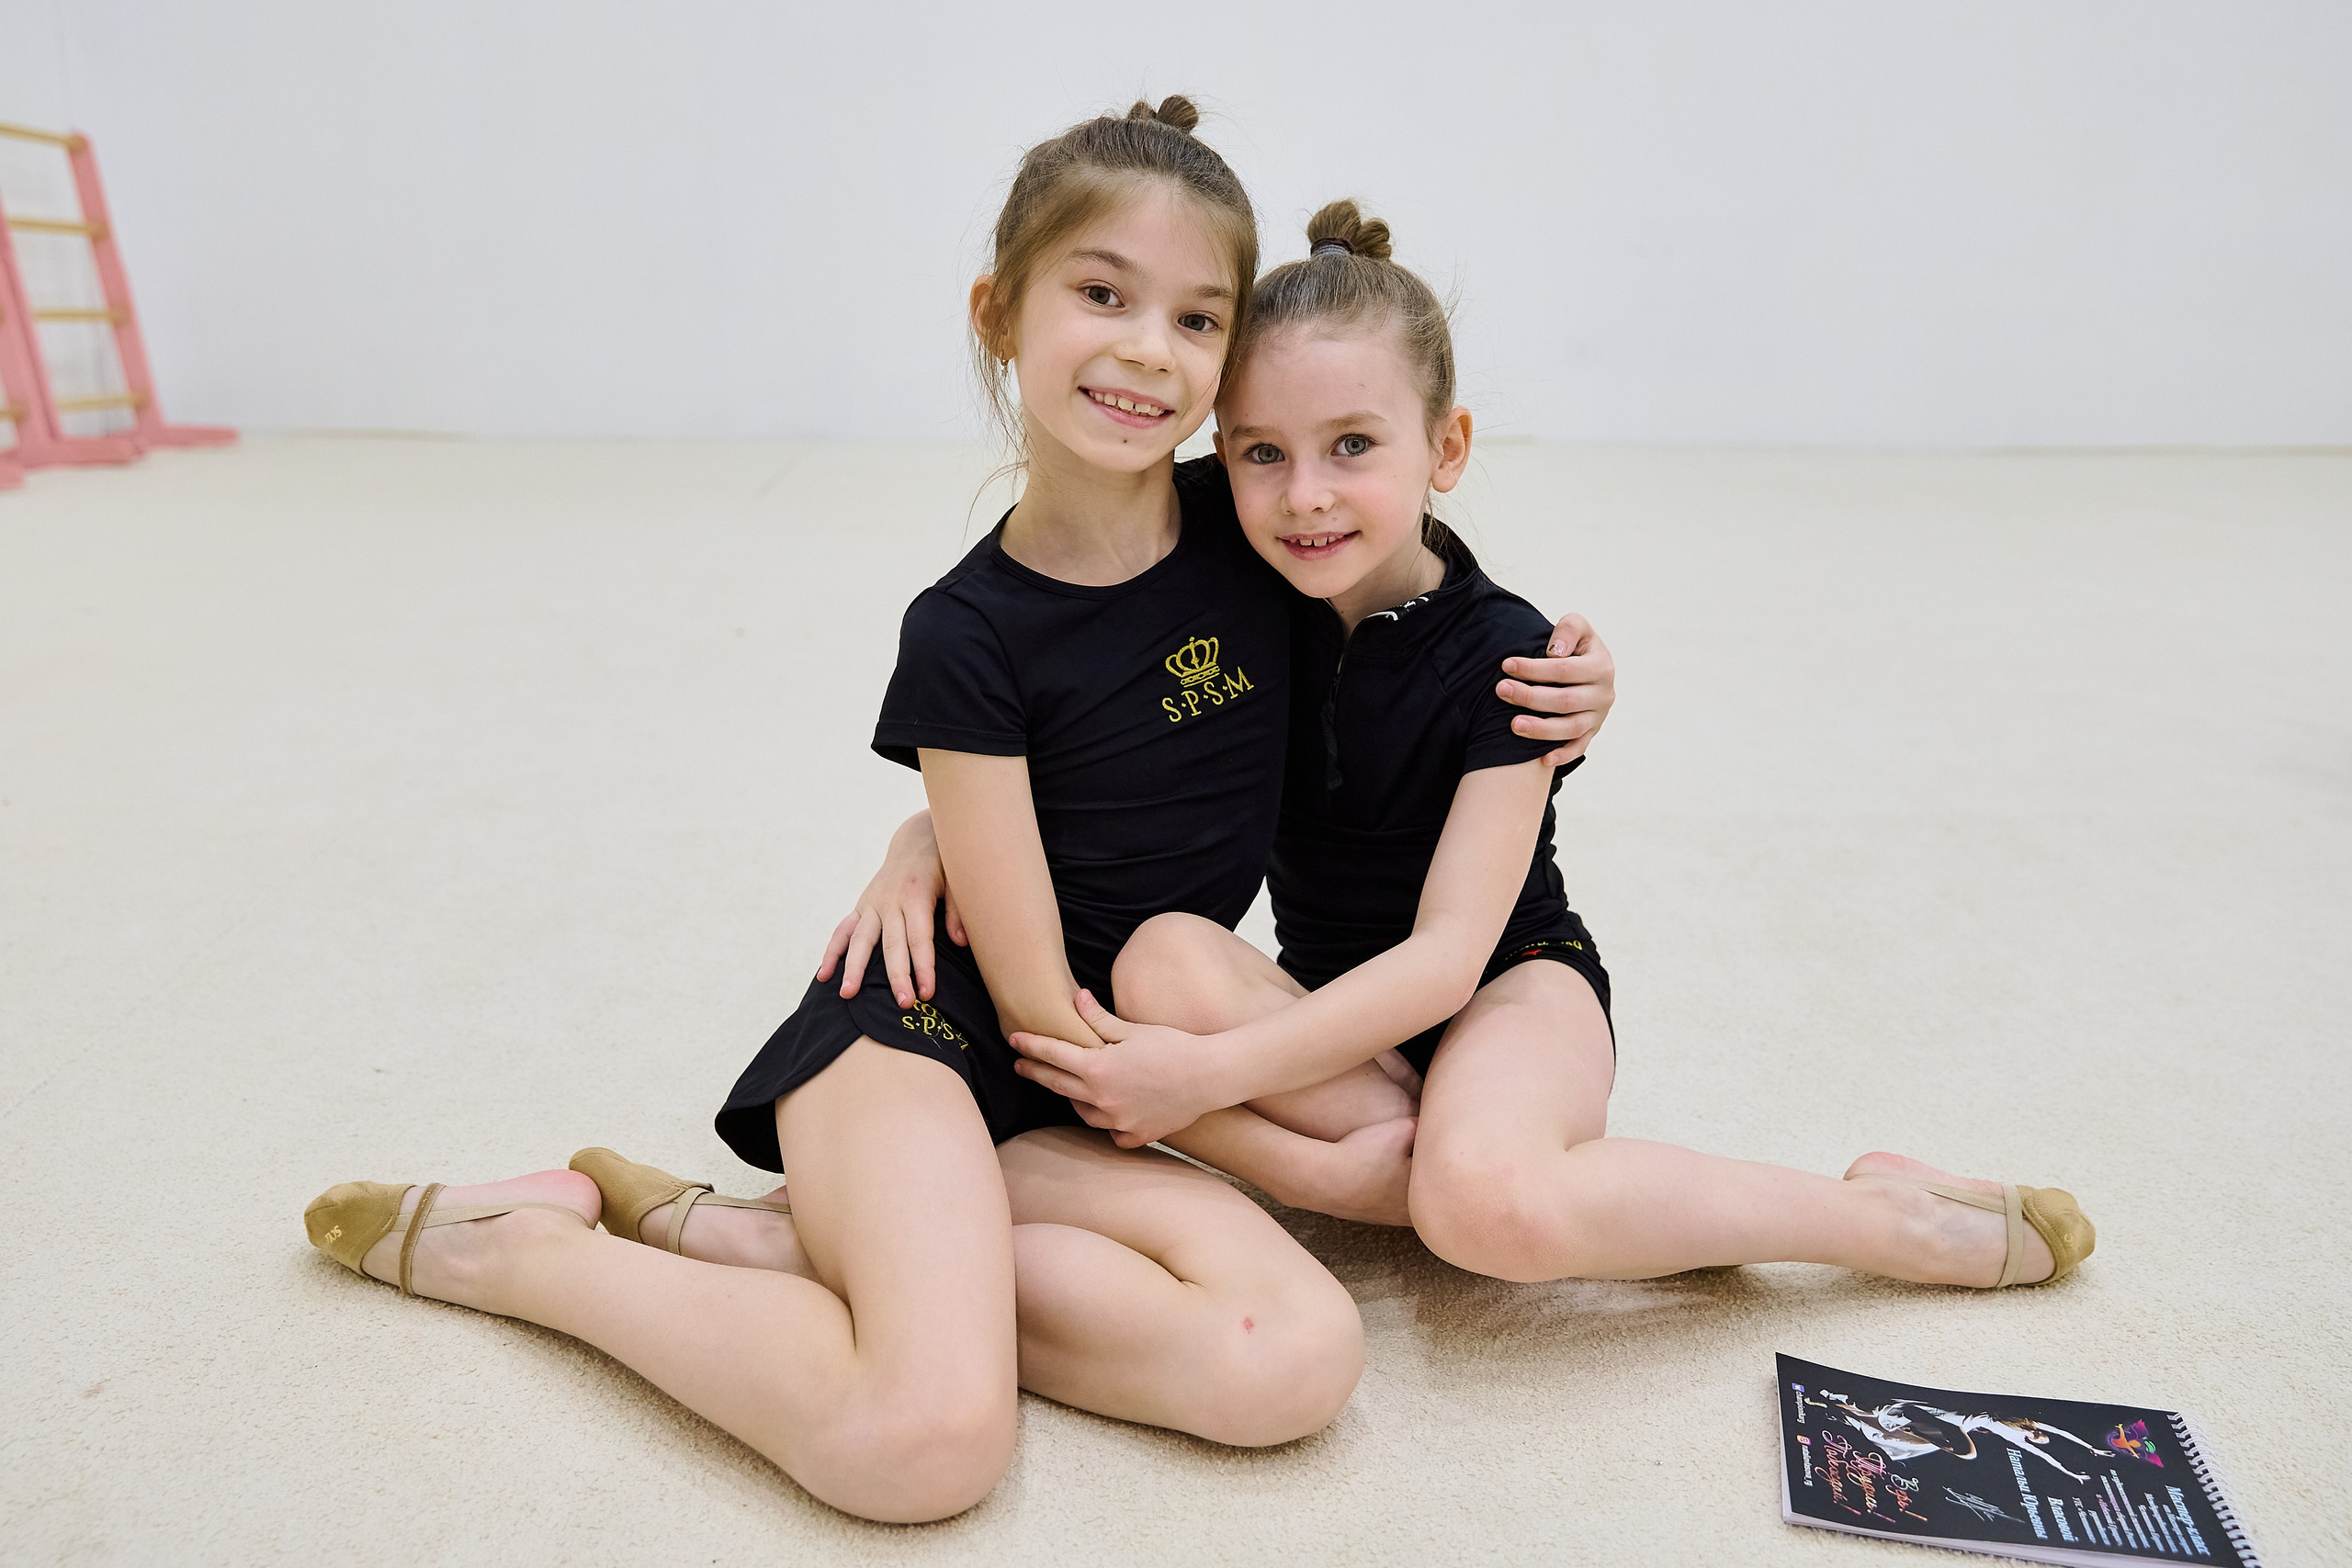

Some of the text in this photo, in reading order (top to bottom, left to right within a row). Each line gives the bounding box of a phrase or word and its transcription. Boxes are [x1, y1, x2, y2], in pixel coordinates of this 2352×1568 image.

[1815, 1430, 1861, 1515] Побеждай!
[1846, 1450, 1895, 1523] Трудись!
[1885, 1472, 1928, 1521] Верь!
[2007, 1448, 2048, 1540] Натальи Юрьевны
[2047, 1496, 2078, 1542] Власовой
[2165, 1485, 2211, 1556] Мастер-класс
